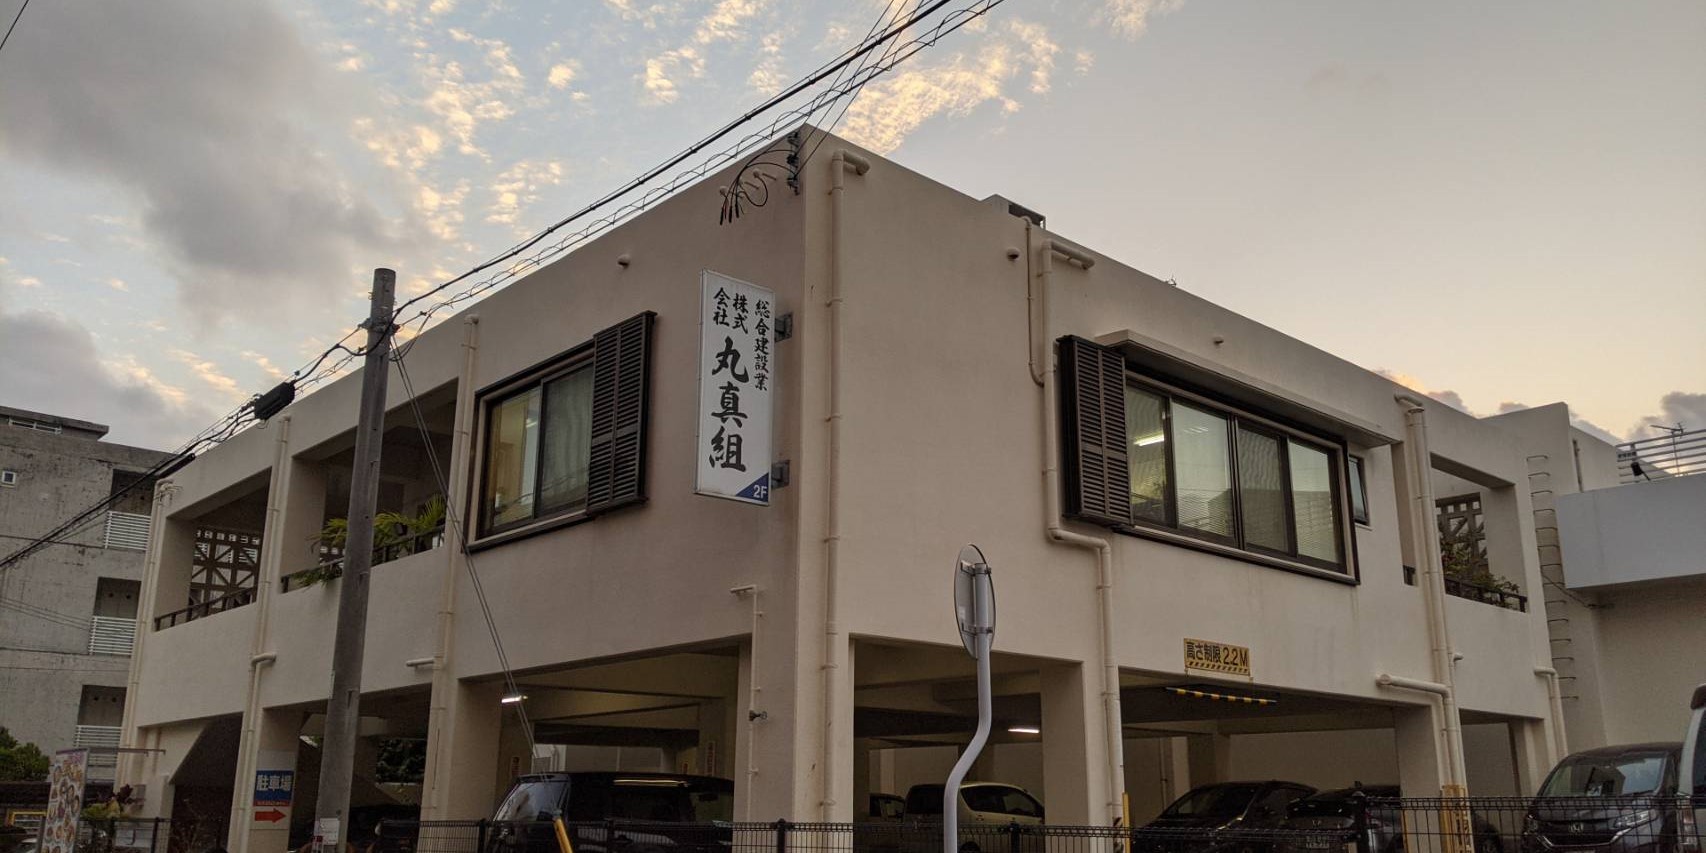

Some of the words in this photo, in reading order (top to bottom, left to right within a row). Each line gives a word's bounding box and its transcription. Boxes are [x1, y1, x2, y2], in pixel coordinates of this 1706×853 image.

[754, 299, 770, 391] 総合建設業
[709, 336, 750, 472] 丸真組
[753, 485, 767, 498] 2F
[256, 775, 293, 791] 駐車場
